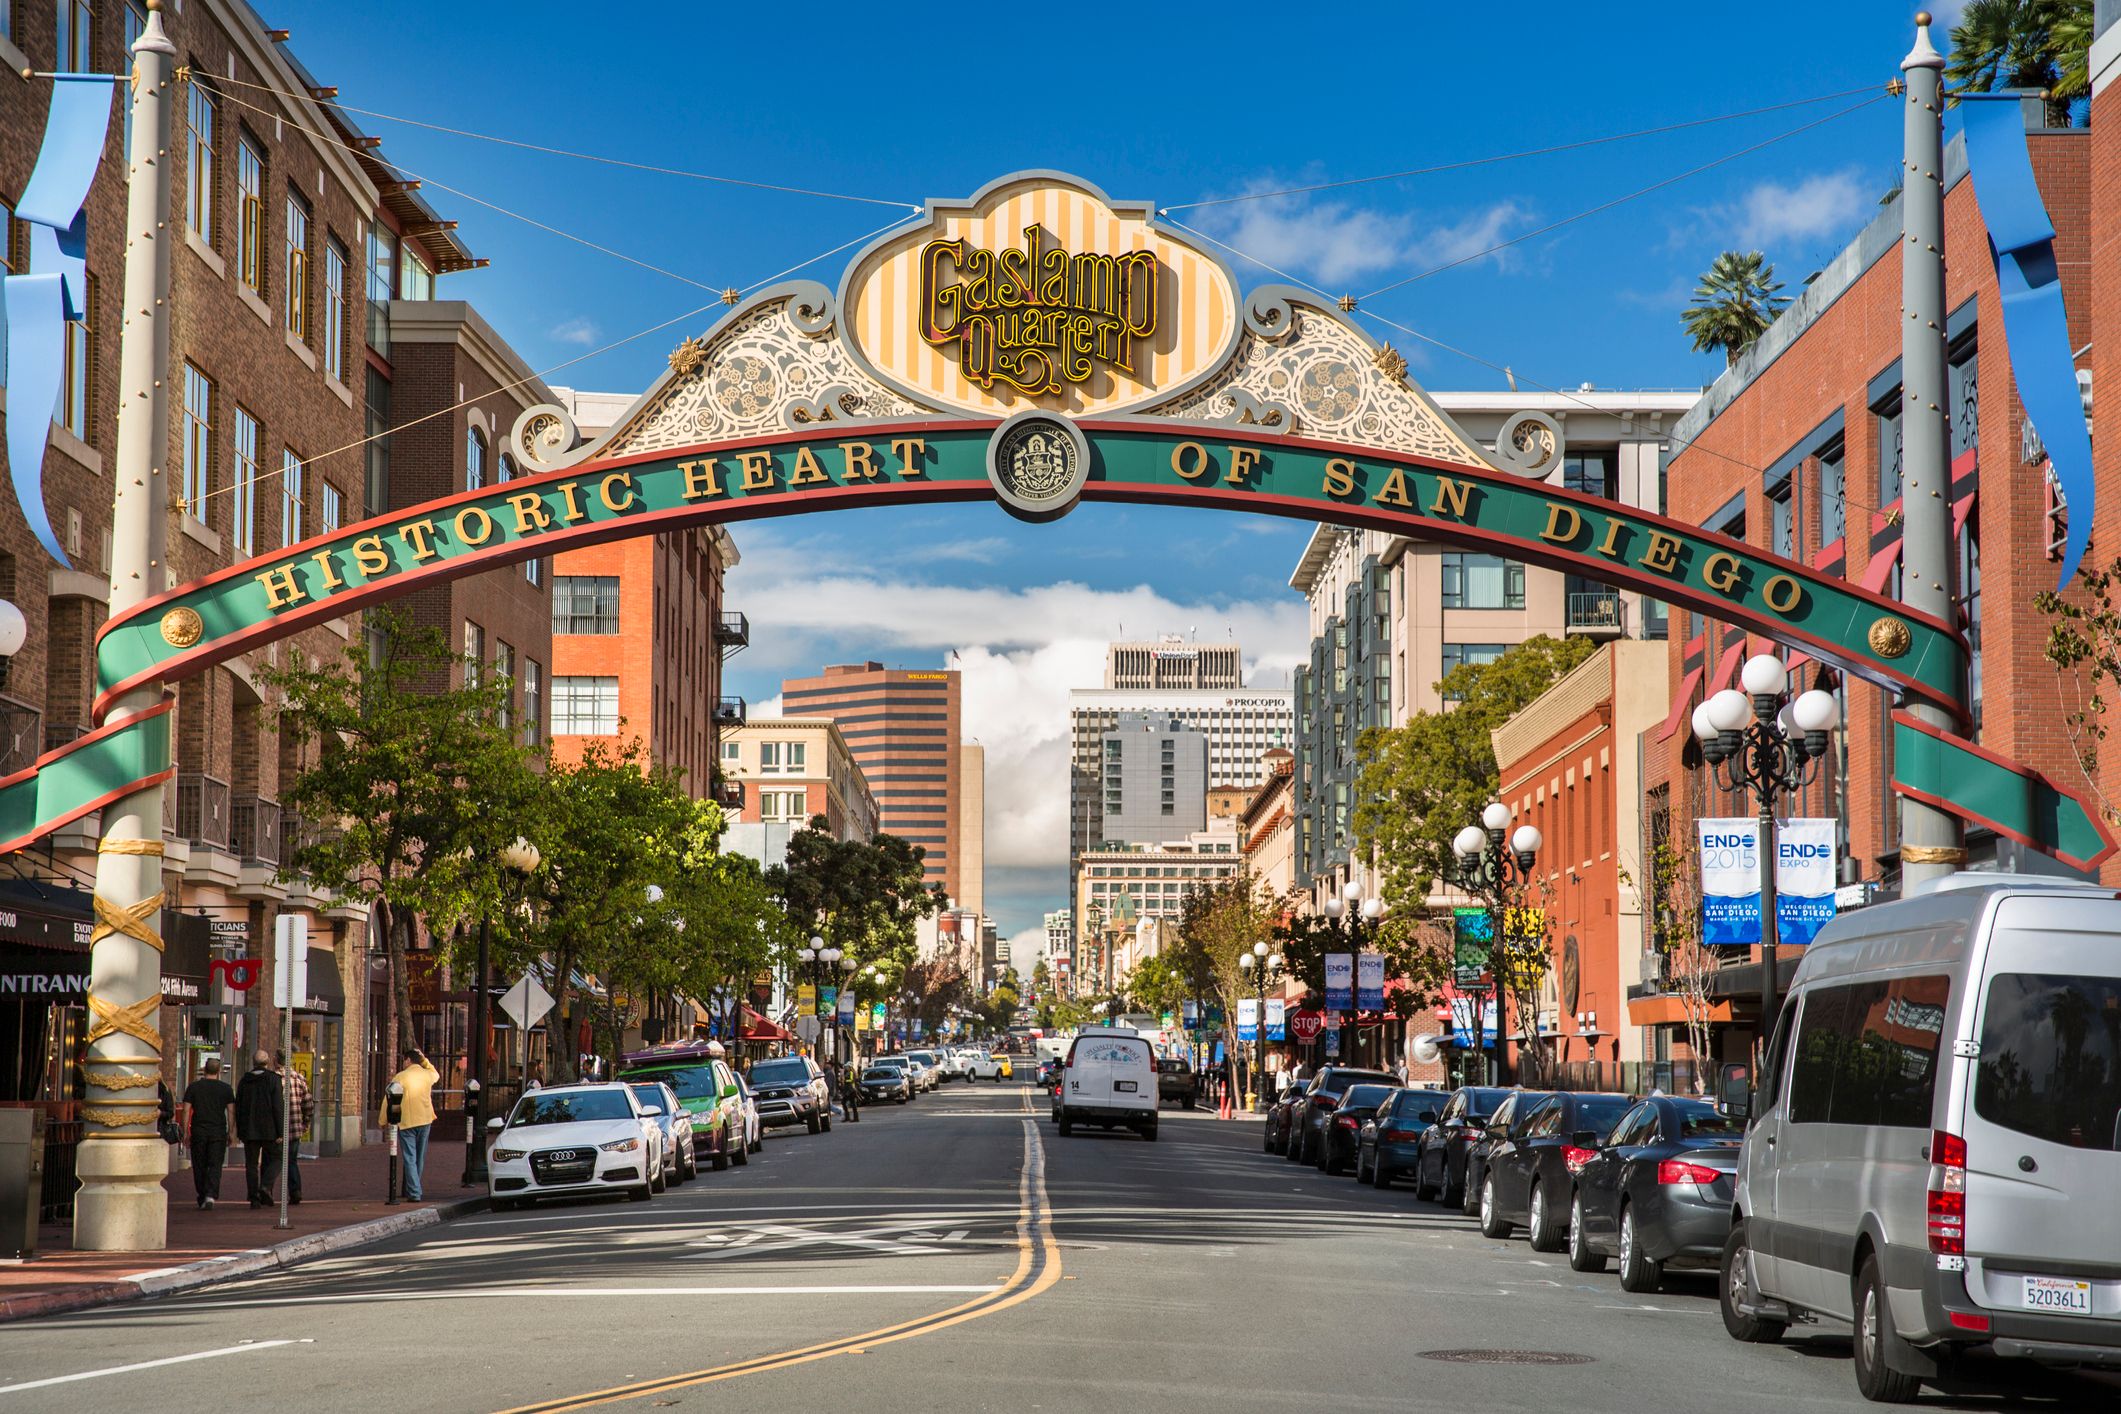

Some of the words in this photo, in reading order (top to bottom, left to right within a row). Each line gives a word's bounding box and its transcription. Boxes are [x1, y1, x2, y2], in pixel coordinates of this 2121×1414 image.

[919, 223, 1160, 345] Gaslamp
[960, 307, 1137, 396] Quarter
[255, 472, 634, 610] HISTORIC
[677, 438, 926, 499] HEART
[1171, 441, 1261, 483] OF
[1322, 458, 1478, 517] SAN
[1539, 502, 1802, 612] DIEGO
[1234, 698, 1286, 707] PROCOPIO
[1704, 848, 1757, 869] 2015
[1780, 859, 1810, 868] EXPO
[1705, 909, 1724, 917] SAN
[1728, 909, 1759, 917] DIEGO
[1780, 909, 1798, 917] SAN
[1802, 909, 1833, 917] DIEGO
[1294, 1018, 1320, 1029] STOP
[1071, 1081, 1080, 1089] 14
[2028, 1288, 2086, 1308] 52036L1
